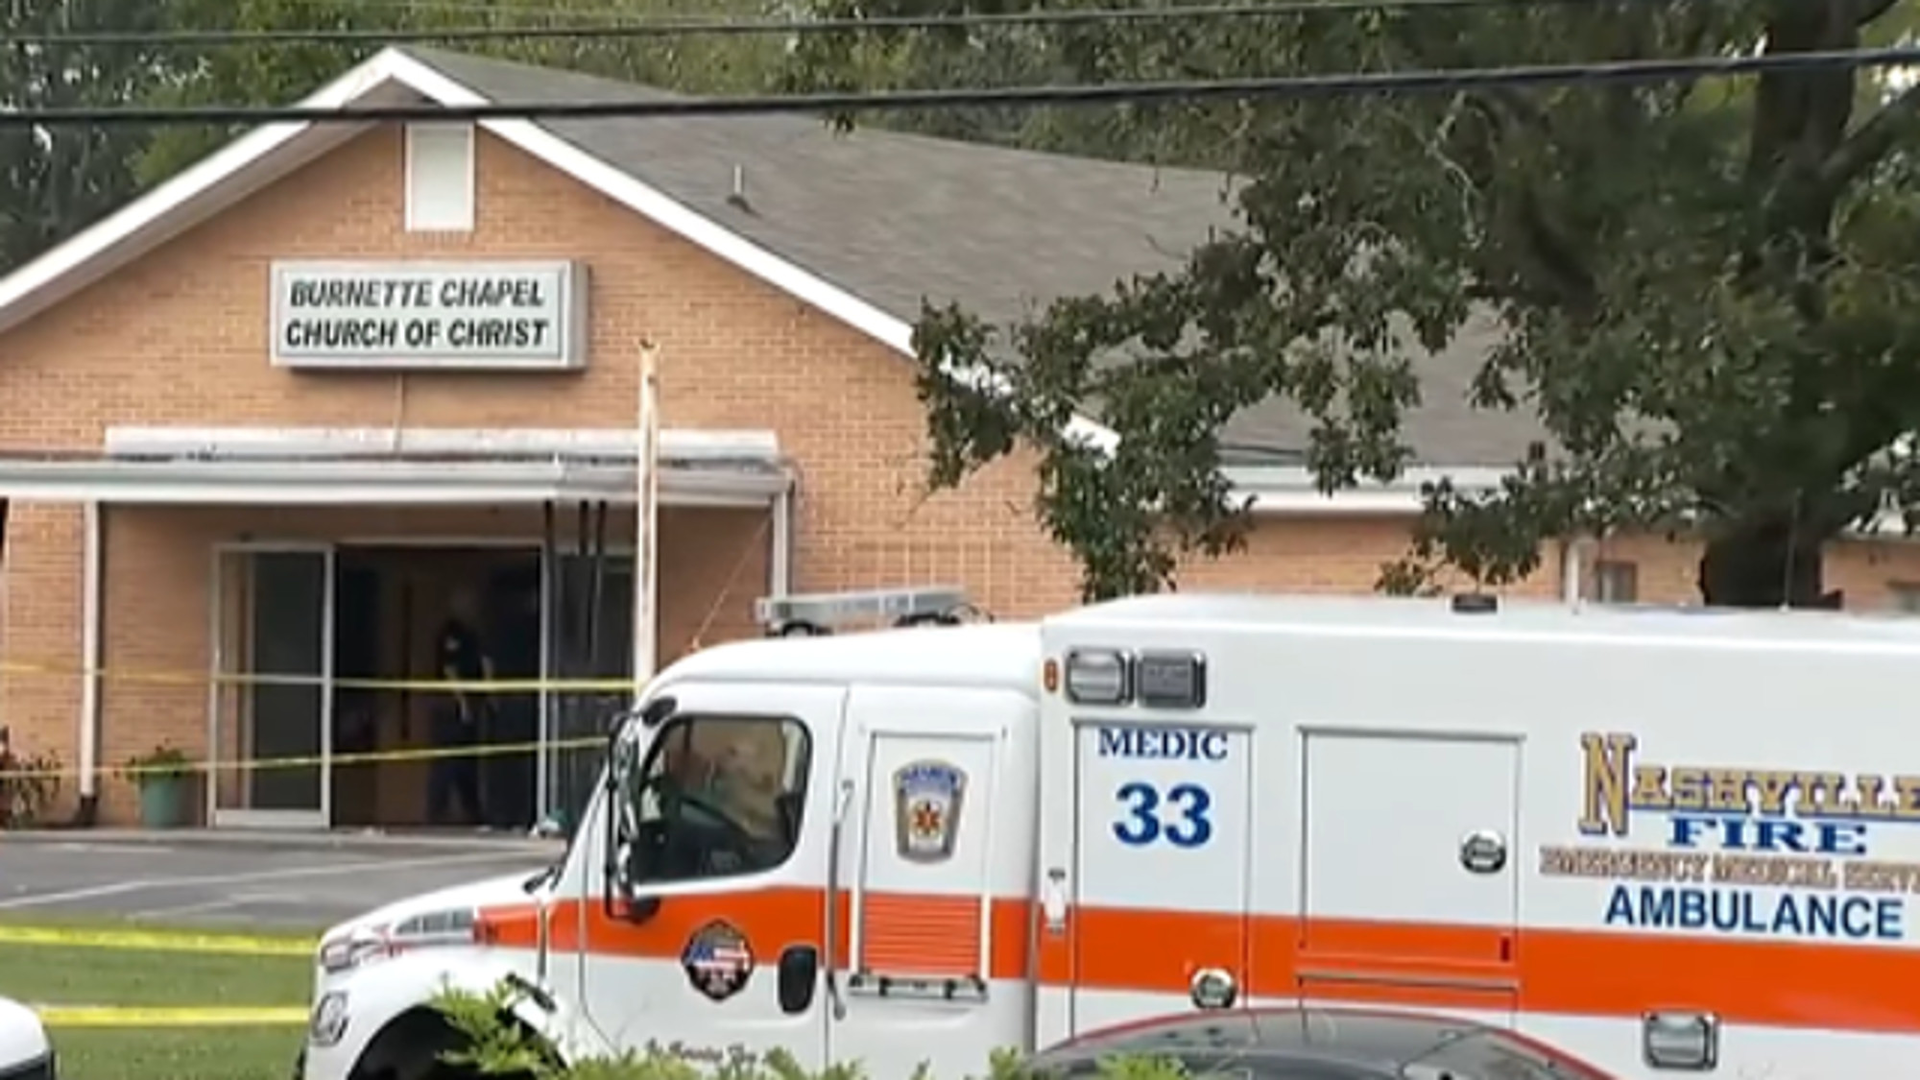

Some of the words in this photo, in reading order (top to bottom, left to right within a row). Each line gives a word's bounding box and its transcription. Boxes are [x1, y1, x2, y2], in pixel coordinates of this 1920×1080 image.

[290, 277, 433, 308] BURNETTE
[439, 277, 546, 308] CHAPEL
[285, 317, 398, 348] CHURCH
[404, 318, 441, 348] OF
[449, 318, 549, 348] CHRIST
[1098, 727, 1229, 760] MEDIC
[1113, 782, 1212, 848] 33
[1667, 816, 1867, 855] FIRE
[1604, 885, 1904, 939] AMBULANCE
